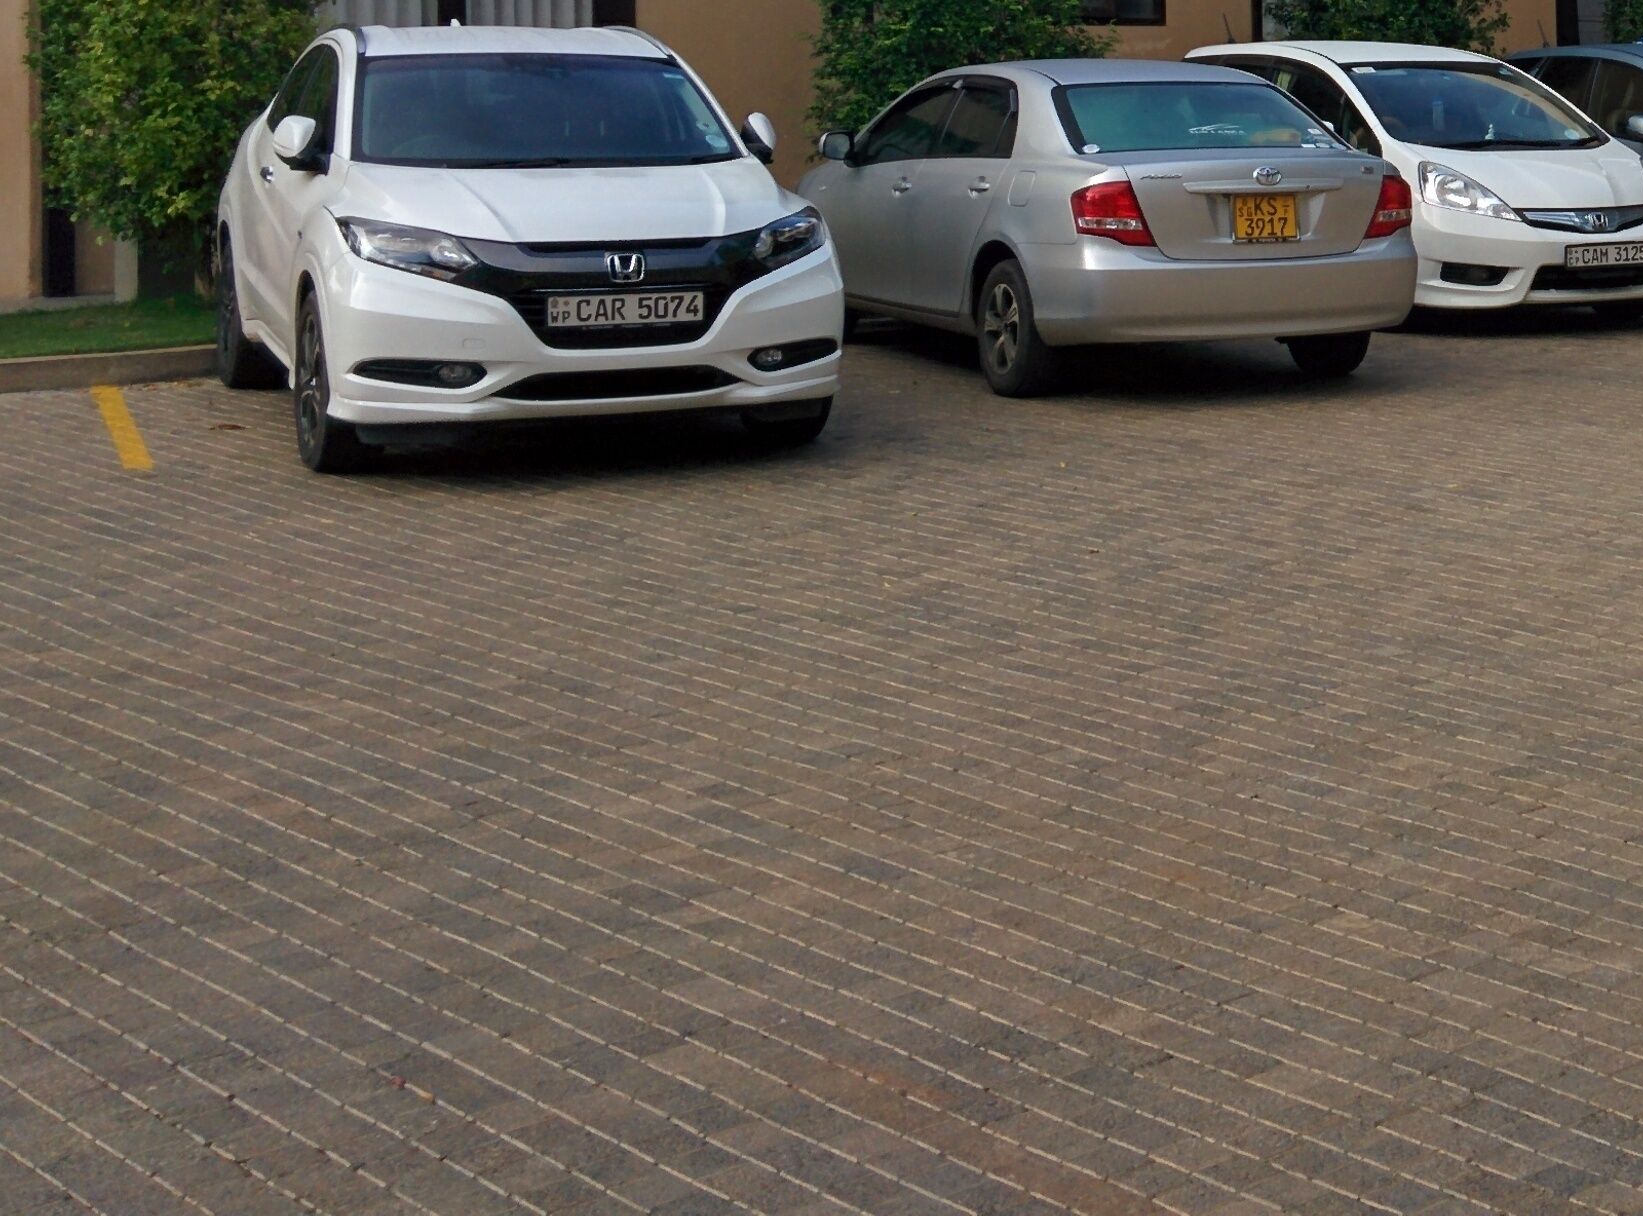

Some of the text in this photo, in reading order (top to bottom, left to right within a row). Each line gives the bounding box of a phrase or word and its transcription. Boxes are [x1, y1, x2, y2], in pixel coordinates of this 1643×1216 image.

[1254, 197, 1277, 216] KS
[1244, 216, 1288, 236] 3917
[1581, 247, 1609, 265] CAM
[550, 294, 699, 324] WP CAR 5074
